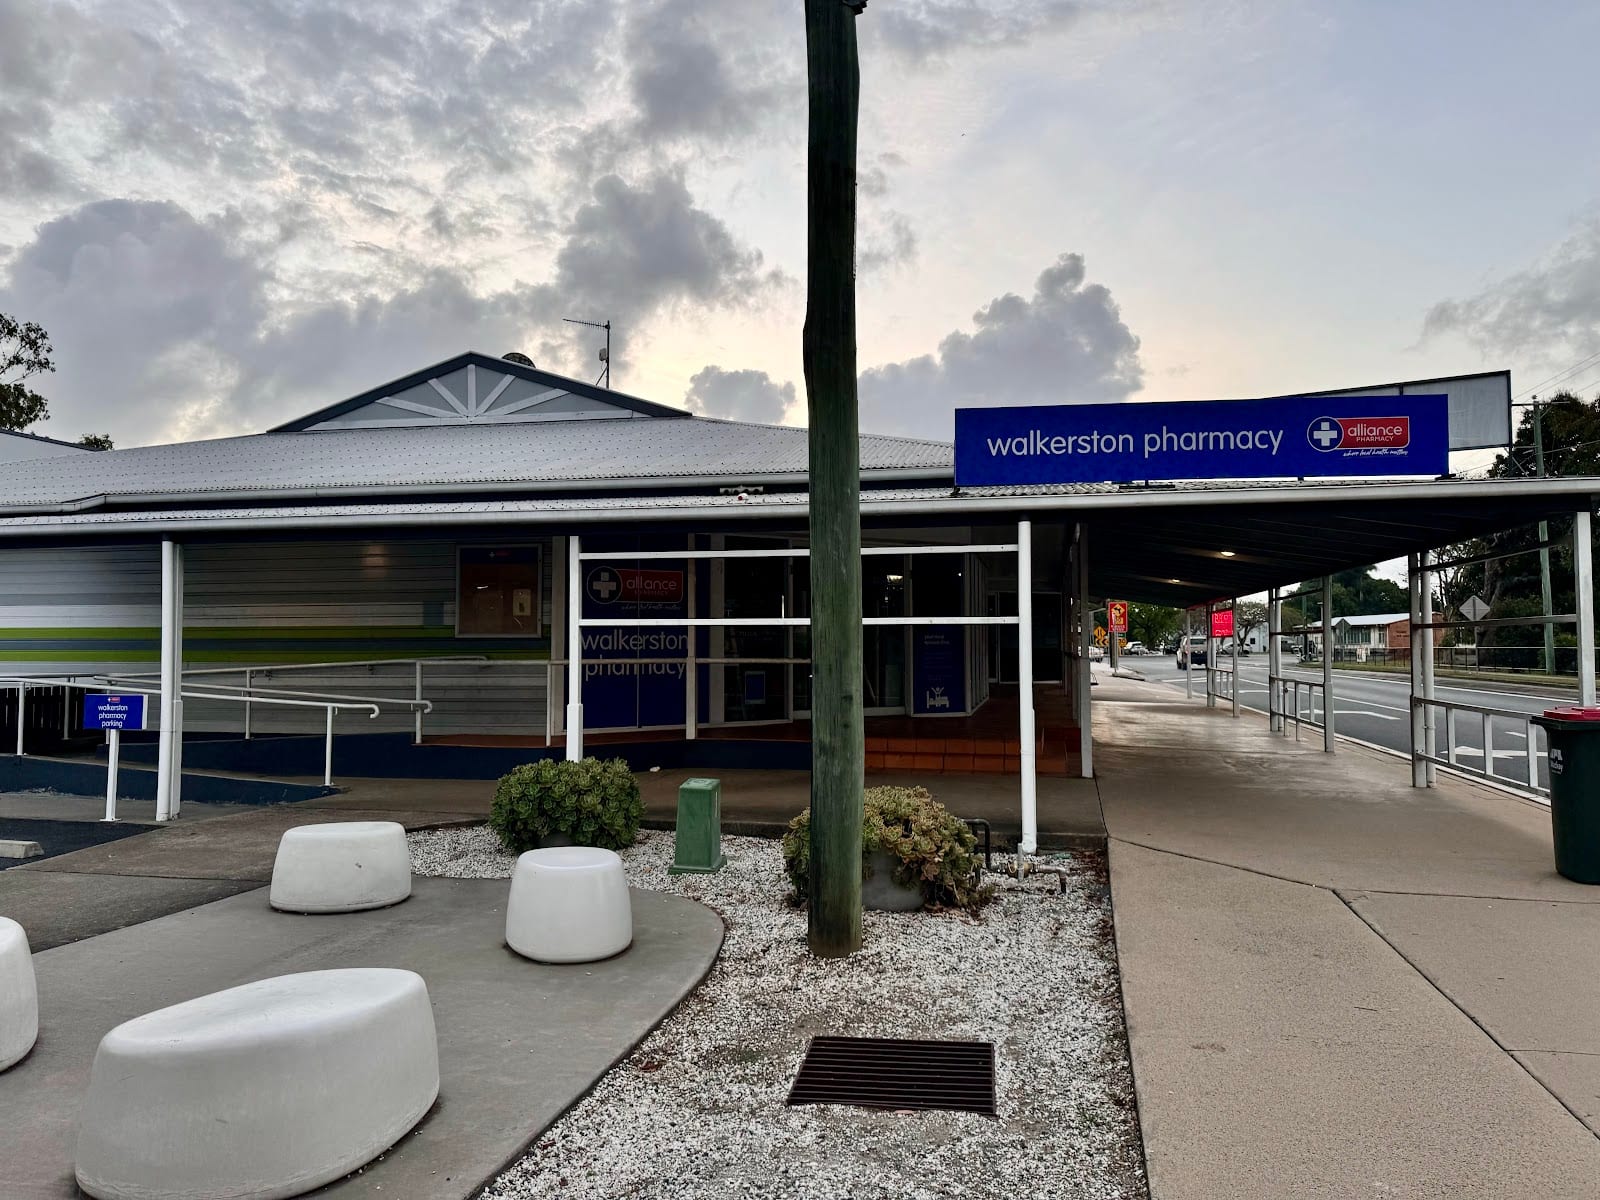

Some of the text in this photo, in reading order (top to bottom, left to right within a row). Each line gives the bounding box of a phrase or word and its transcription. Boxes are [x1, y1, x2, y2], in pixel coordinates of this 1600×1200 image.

[1348, 423, 1403, 438] alliance
[986, 425, 1284, 459] walkerston pharmacy
[582, 628, 688, 651] walkerston
[585, 653, 686, 682] pharmacy
[98, 703, 128, 711] walkerston
[98, 712, 127, 721] pharmacy
[101, 720, 123, 729] parking
